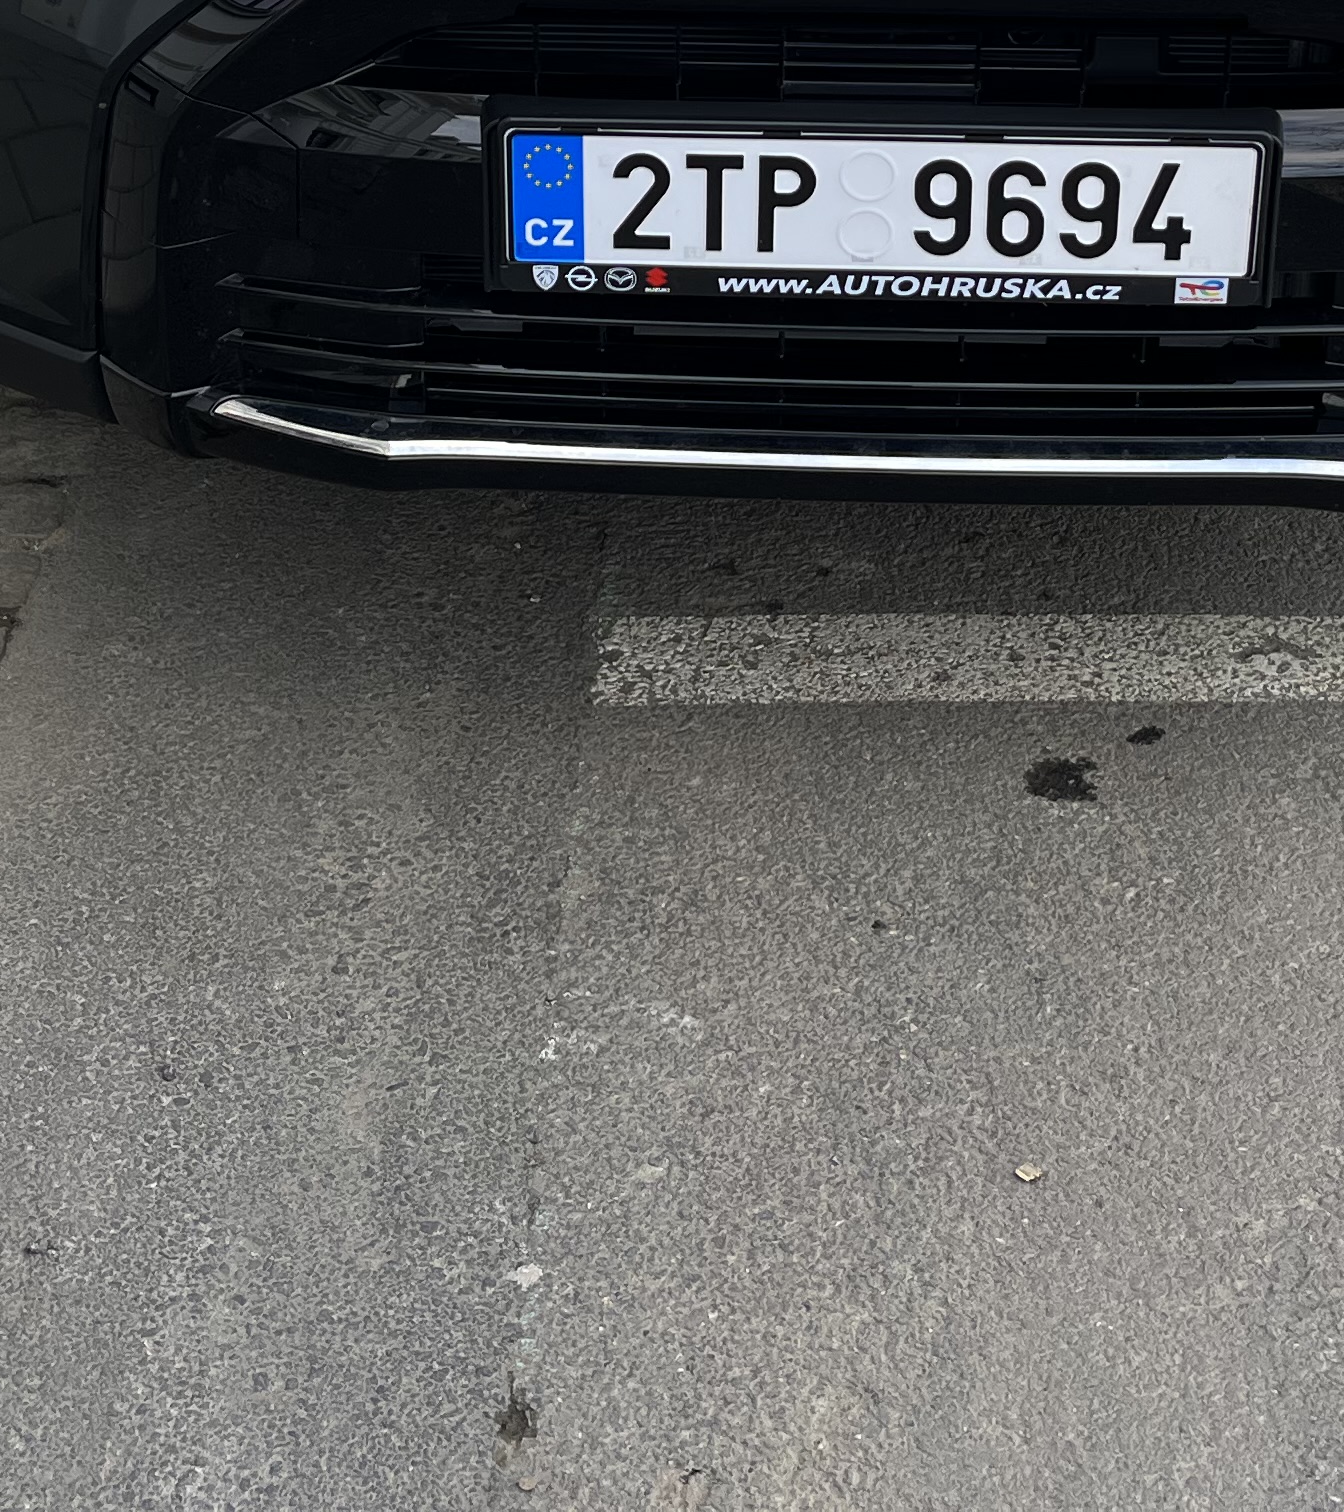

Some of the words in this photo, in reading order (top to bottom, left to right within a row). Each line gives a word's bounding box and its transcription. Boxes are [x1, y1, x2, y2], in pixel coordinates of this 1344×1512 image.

[612, 152, 817, 253] 2TP
[912, 158, 1192, 261] 9694
[524, 218, 575, 247] CZ
[716, 274, 1123, 301] www.AUTOHRUSKA.cz
